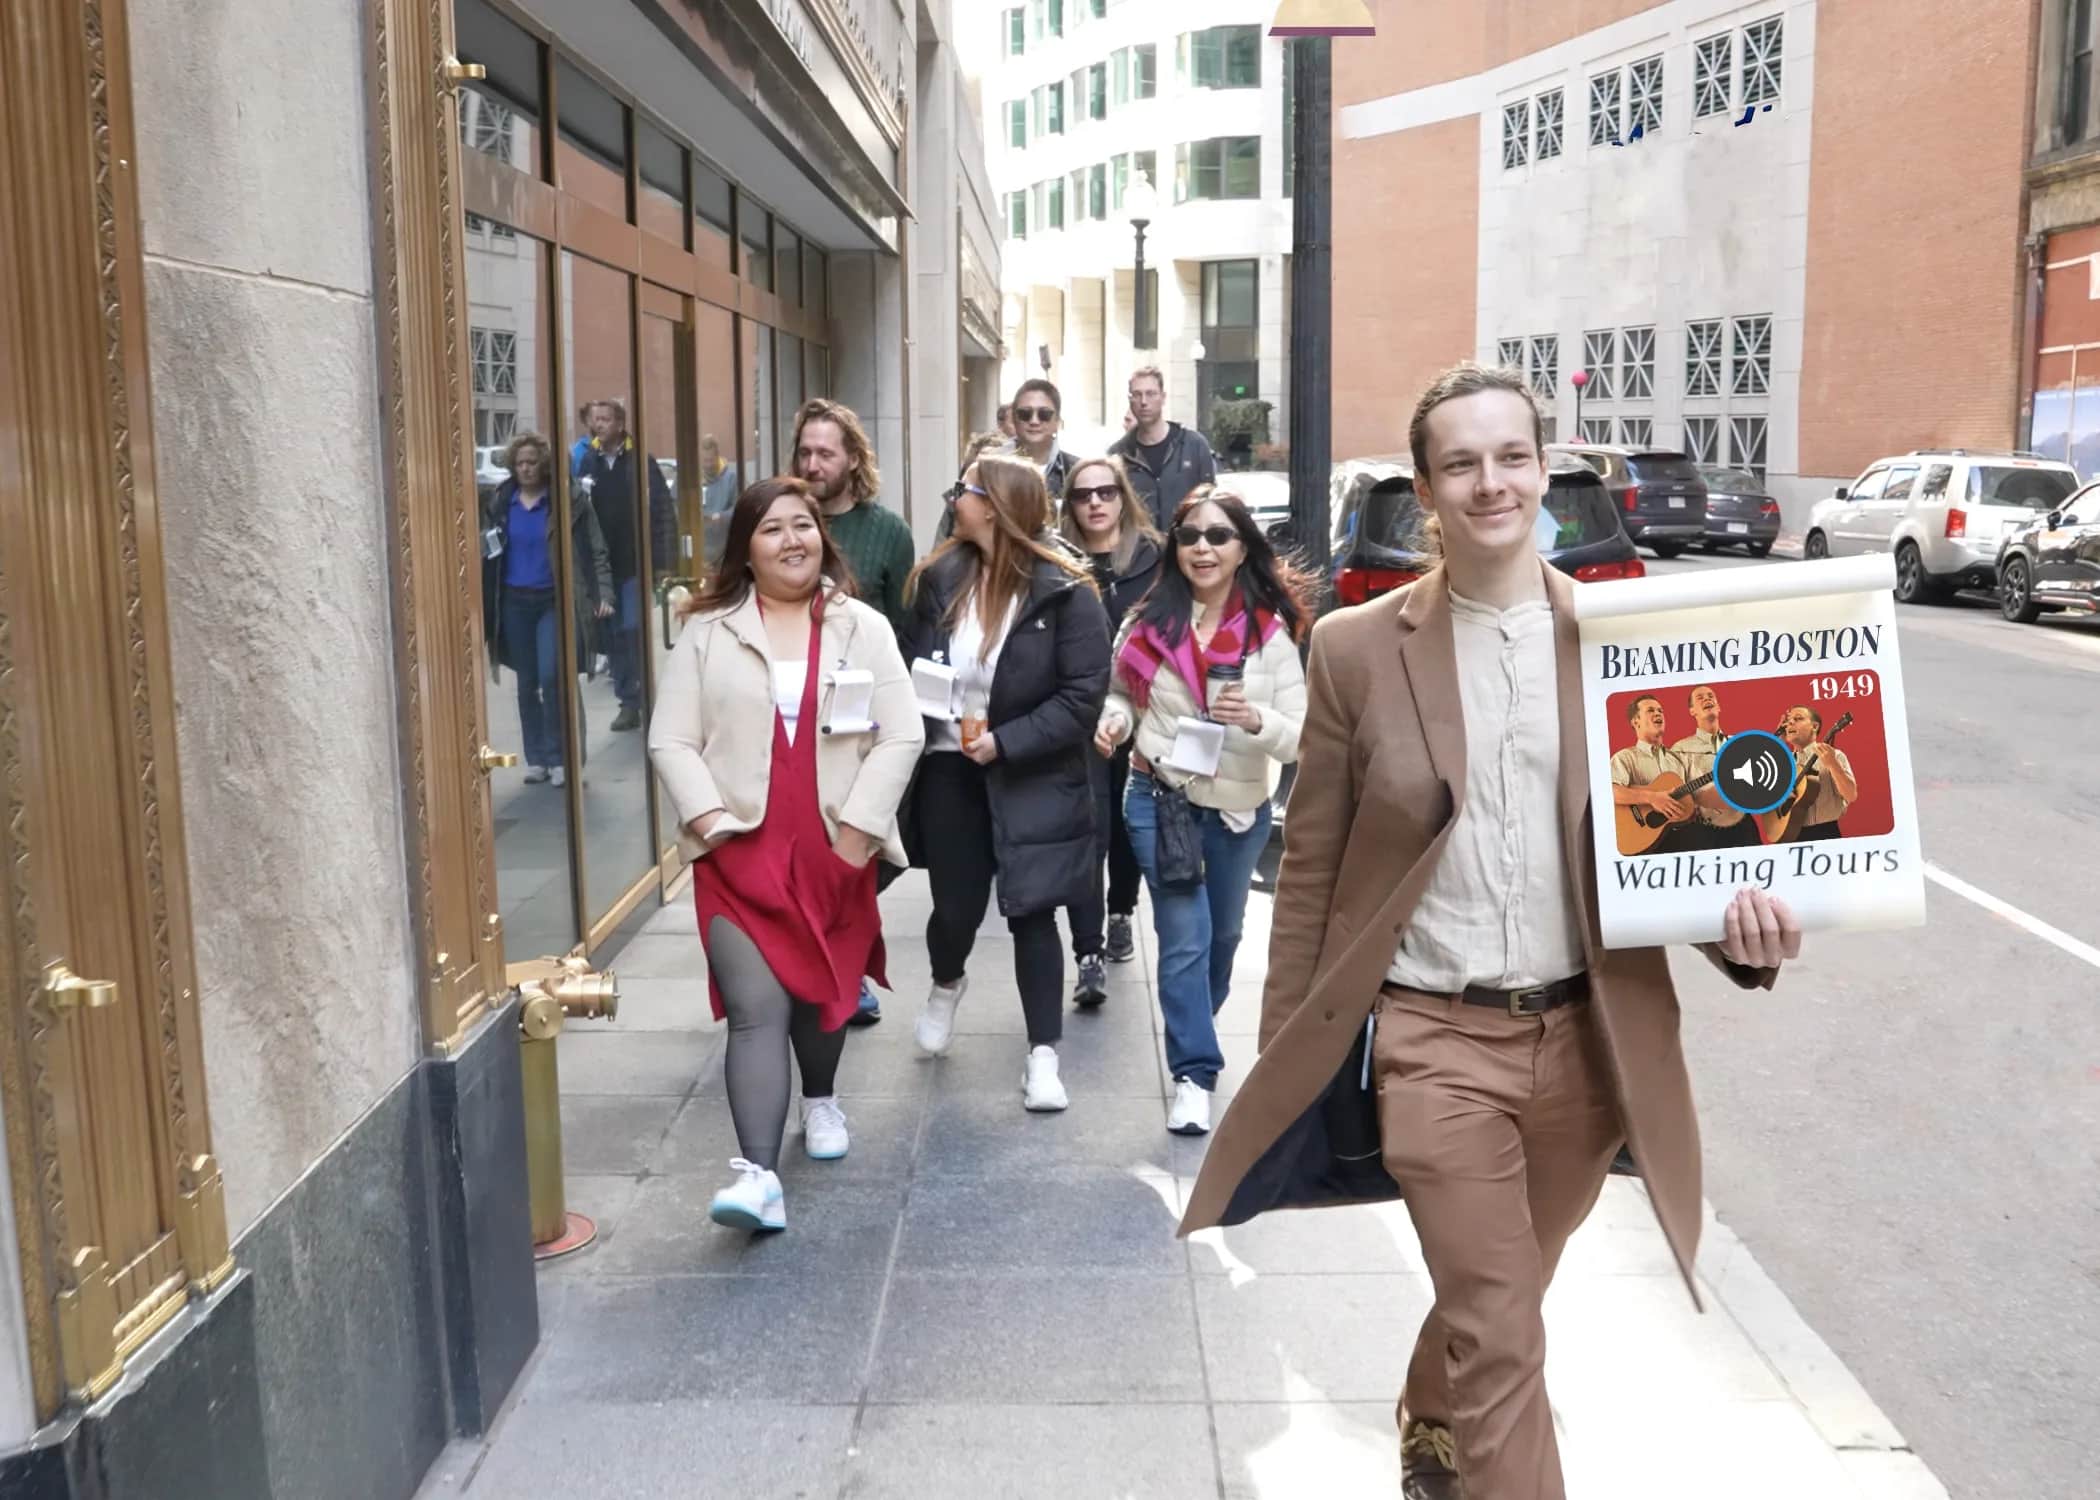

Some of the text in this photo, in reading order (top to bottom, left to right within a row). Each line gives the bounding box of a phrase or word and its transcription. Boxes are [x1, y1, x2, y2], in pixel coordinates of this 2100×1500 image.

[1600, 624, 1883, 679] BEAMING BOSTON
[1809, 674, 1875, 701] 1949
[1614, 845, 1899, 890] Walking Tours
